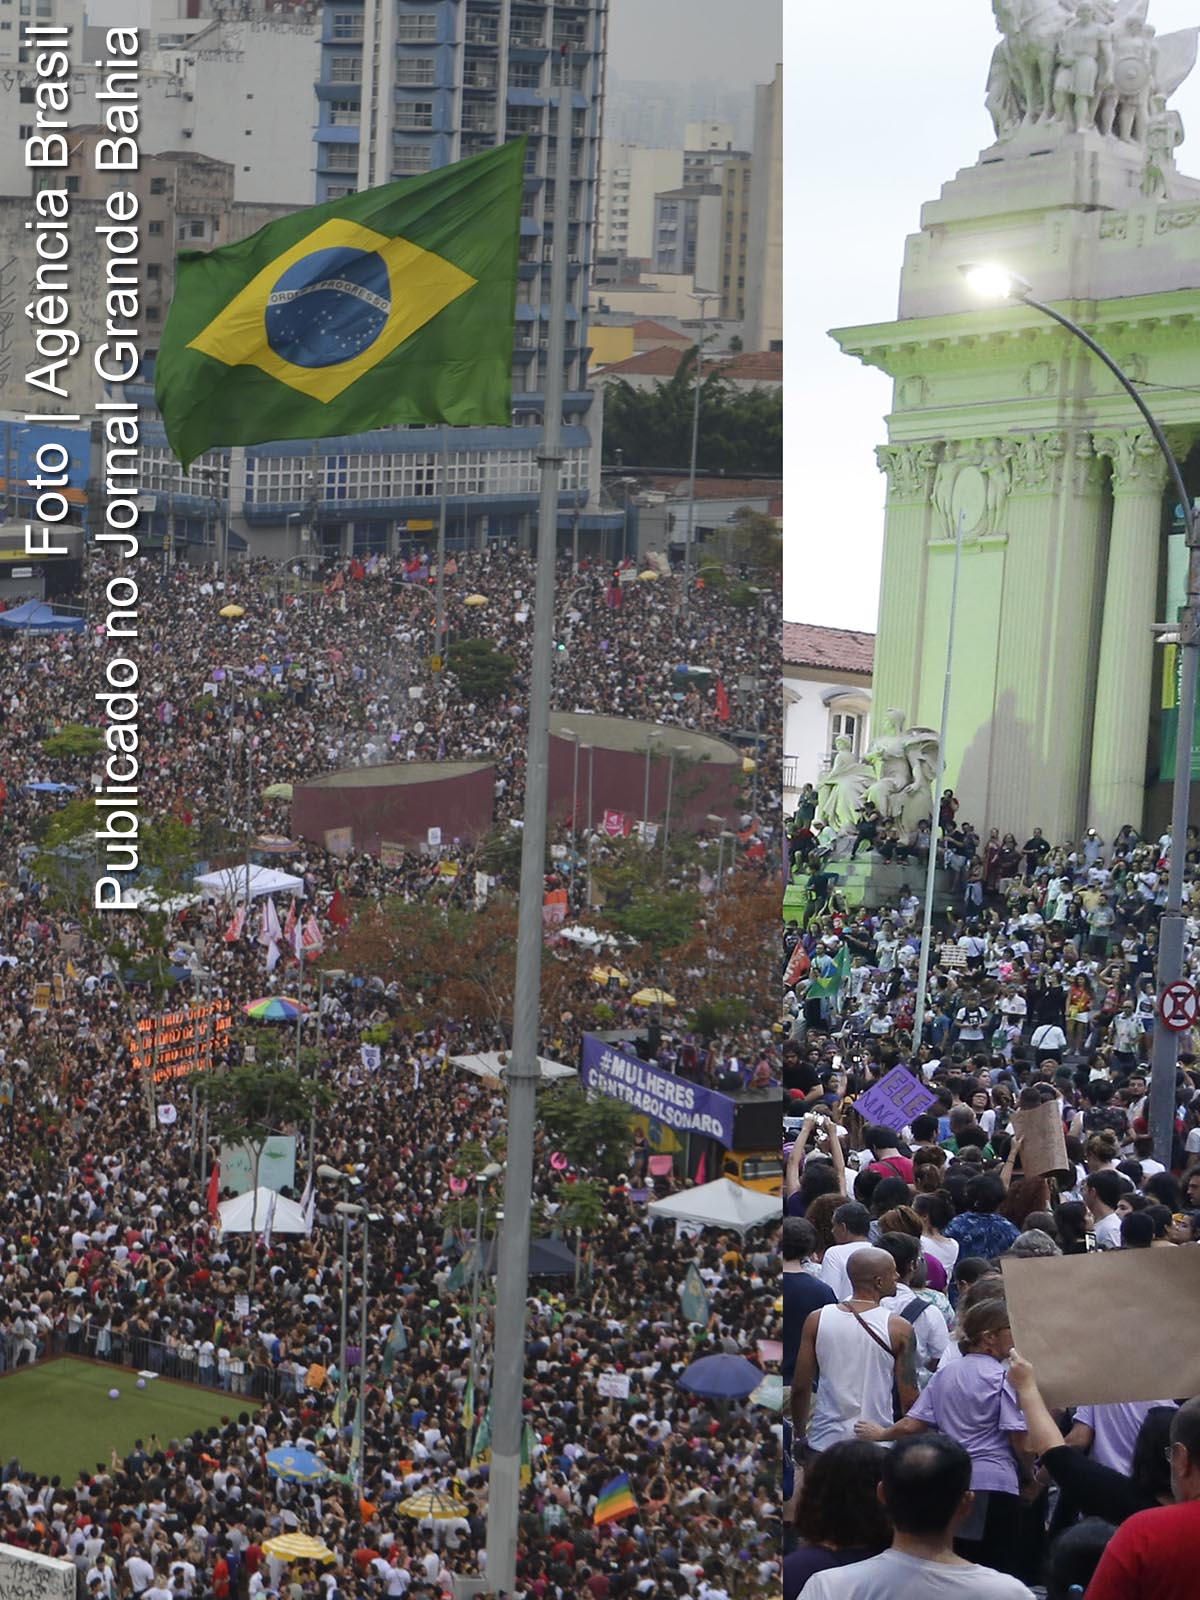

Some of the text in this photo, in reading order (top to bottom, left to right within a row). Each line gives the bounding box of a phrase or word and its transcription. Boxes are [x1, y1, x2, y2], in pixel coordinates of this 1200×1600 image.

[320, 280, 389, 311] PROGRESSO
[588, 1067, 724, 1138] CONTRABOLSONARO
[600, 1050, 695, 1110] #MULHERES
[879, 1069, 932, 1118] ELE
